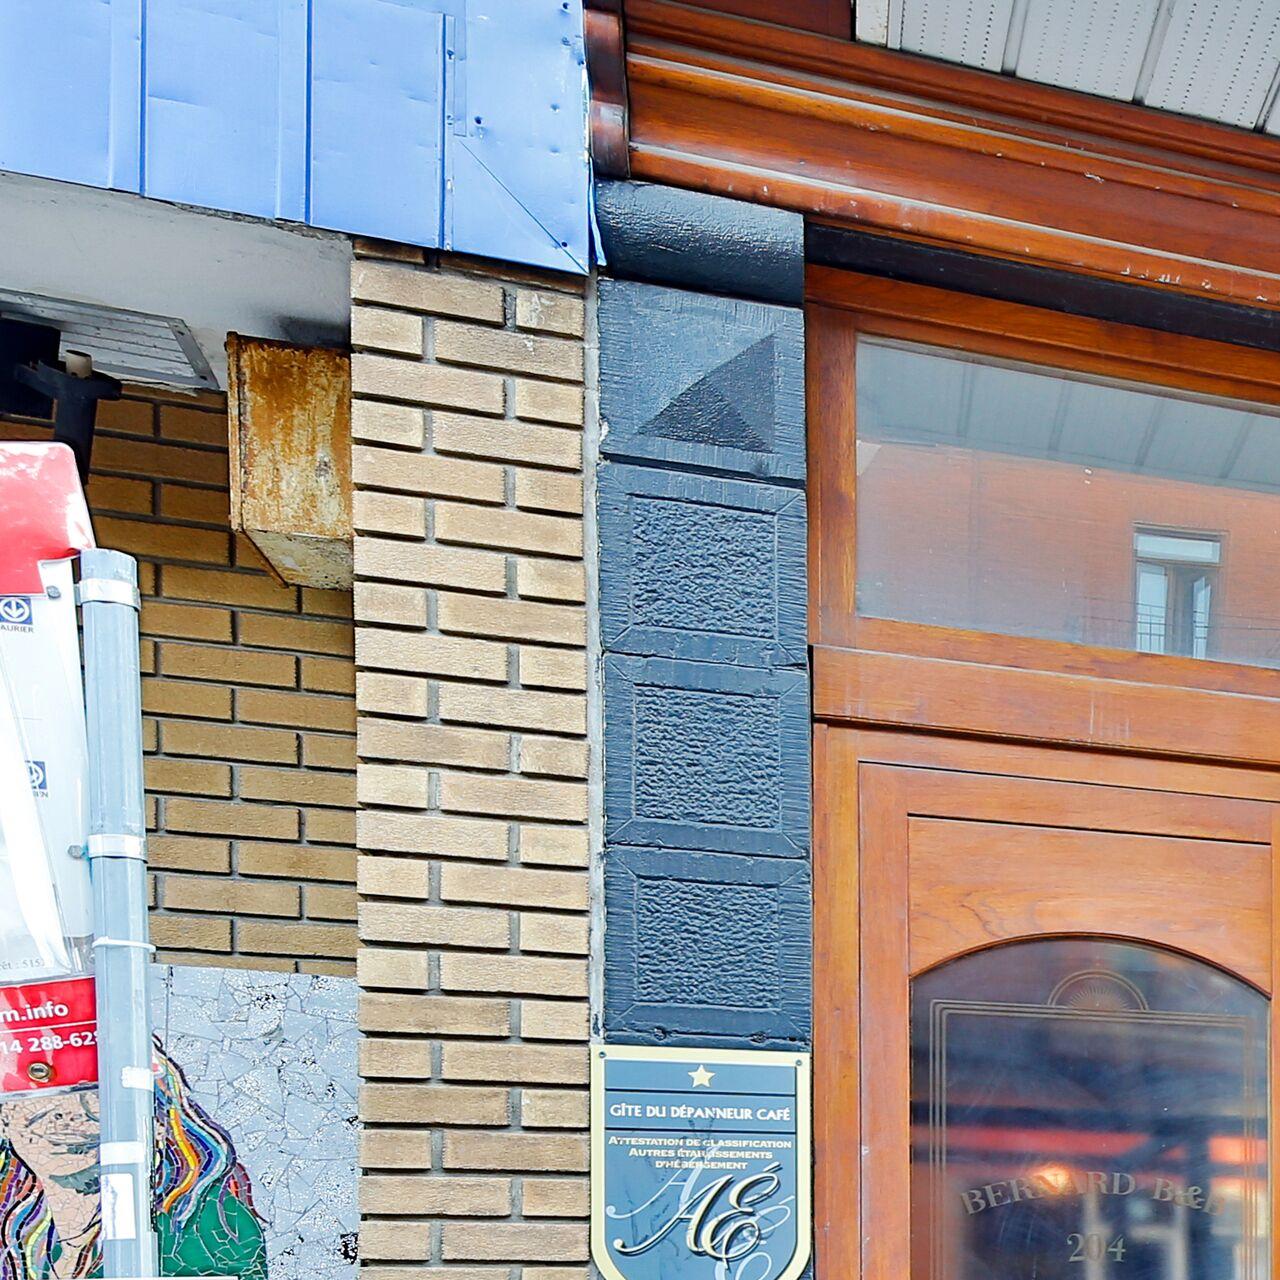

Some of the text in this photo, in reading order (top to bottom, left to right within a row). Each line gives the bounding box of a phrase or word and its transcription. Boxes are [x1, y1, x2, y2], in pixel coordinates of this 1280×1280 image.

[0, 1001, 69, 1022] m.info
[28, 1030, 97, 1052] 288-62
[610, 1103, 791, 1121] GÎTE DU DÉPANNEUR CAFÉ
[608, 1136, 792, 1149] ATTESTATION DE CLASSIFICATION
[629, 1148, 675, 1157] AUTRES
[961, 1170, 1136, 1215] BERNARD
[1066, 1233, 1126, 1263] 204
